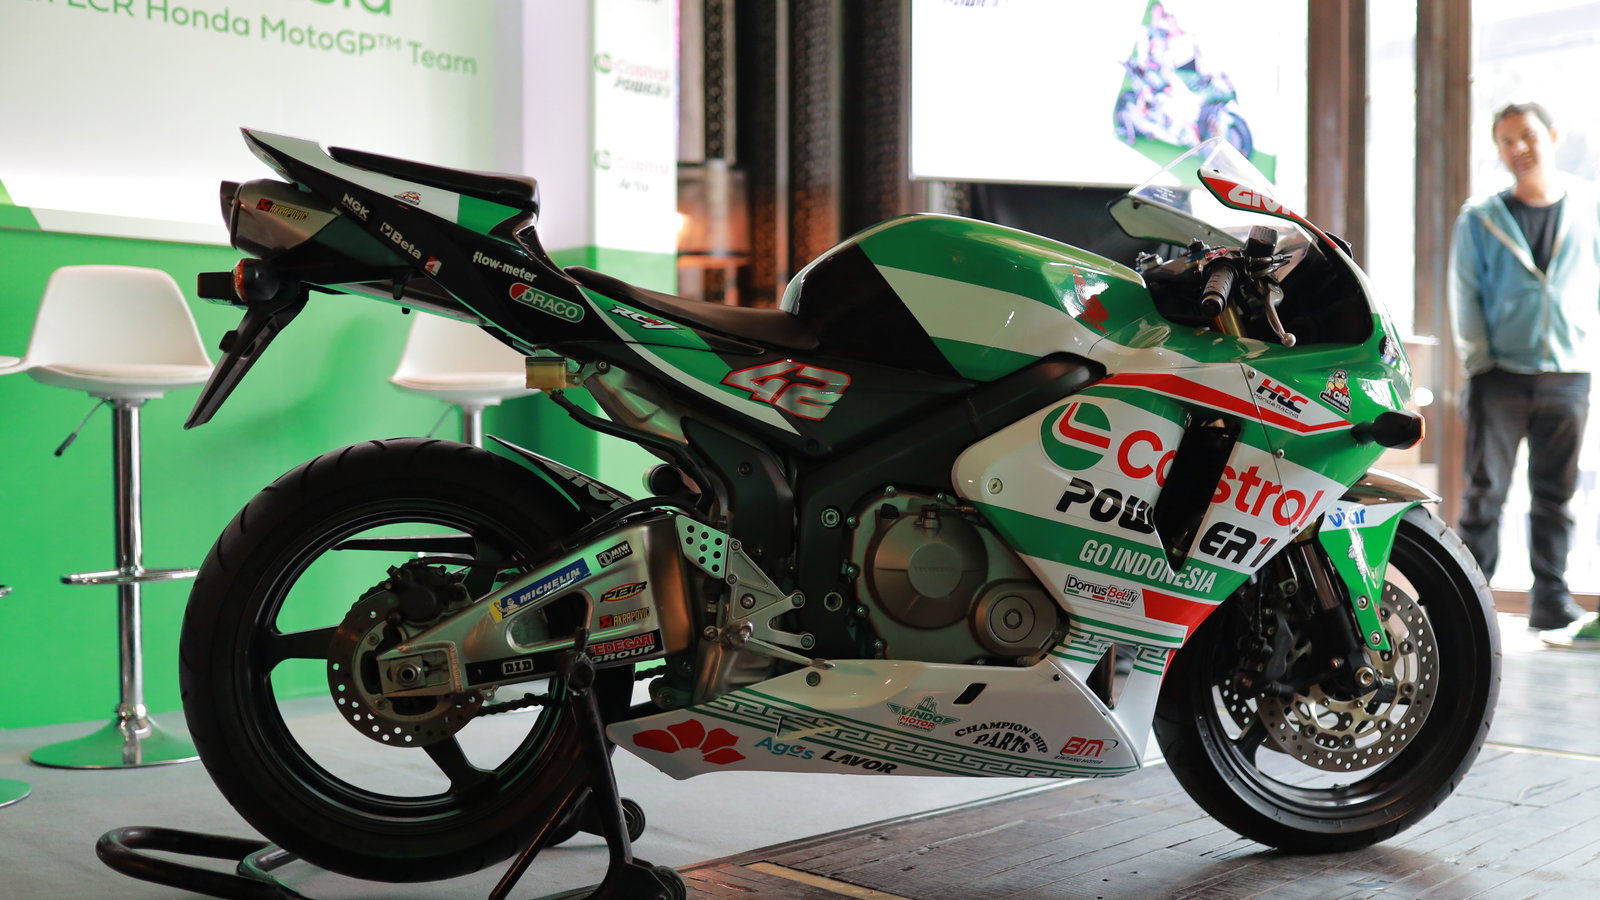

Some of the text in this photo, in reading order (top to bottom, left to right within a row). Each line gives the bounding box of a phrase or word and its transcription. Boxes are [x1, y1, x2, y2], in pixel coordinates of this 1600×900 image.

[147, 0, 250, 36] Honda
[407, 40, 478, 75] Team
[342, 193, 370, 219] NGK
[1228, 184, 1292, 216] GIVI
[391, 231, 422, 260] Beta
[473, 251, 537, 282] flow-meter
[521, 288, 578, 319] DRACO
[720, 358, 851, 422] 42
[1256, 378, 1309, 414] HRC
[1079, 539, 1218, 593] GO INDONESIA
[519, 567, 582, 604] MICHELIN
[600, 581, 648, 602] PBR
[591, 644, 656, 664] GROUP
[900, 716, 935, 729] MOTOR
[901, 706, 943, 723] VINDO
[954, 721, 1049, 754] CHAMPION SHIP
[973, 731, 1032, 754] PARTS
[1060, 736, 1105, 758] BM
[820, 750, 898, 774] LAVOR
